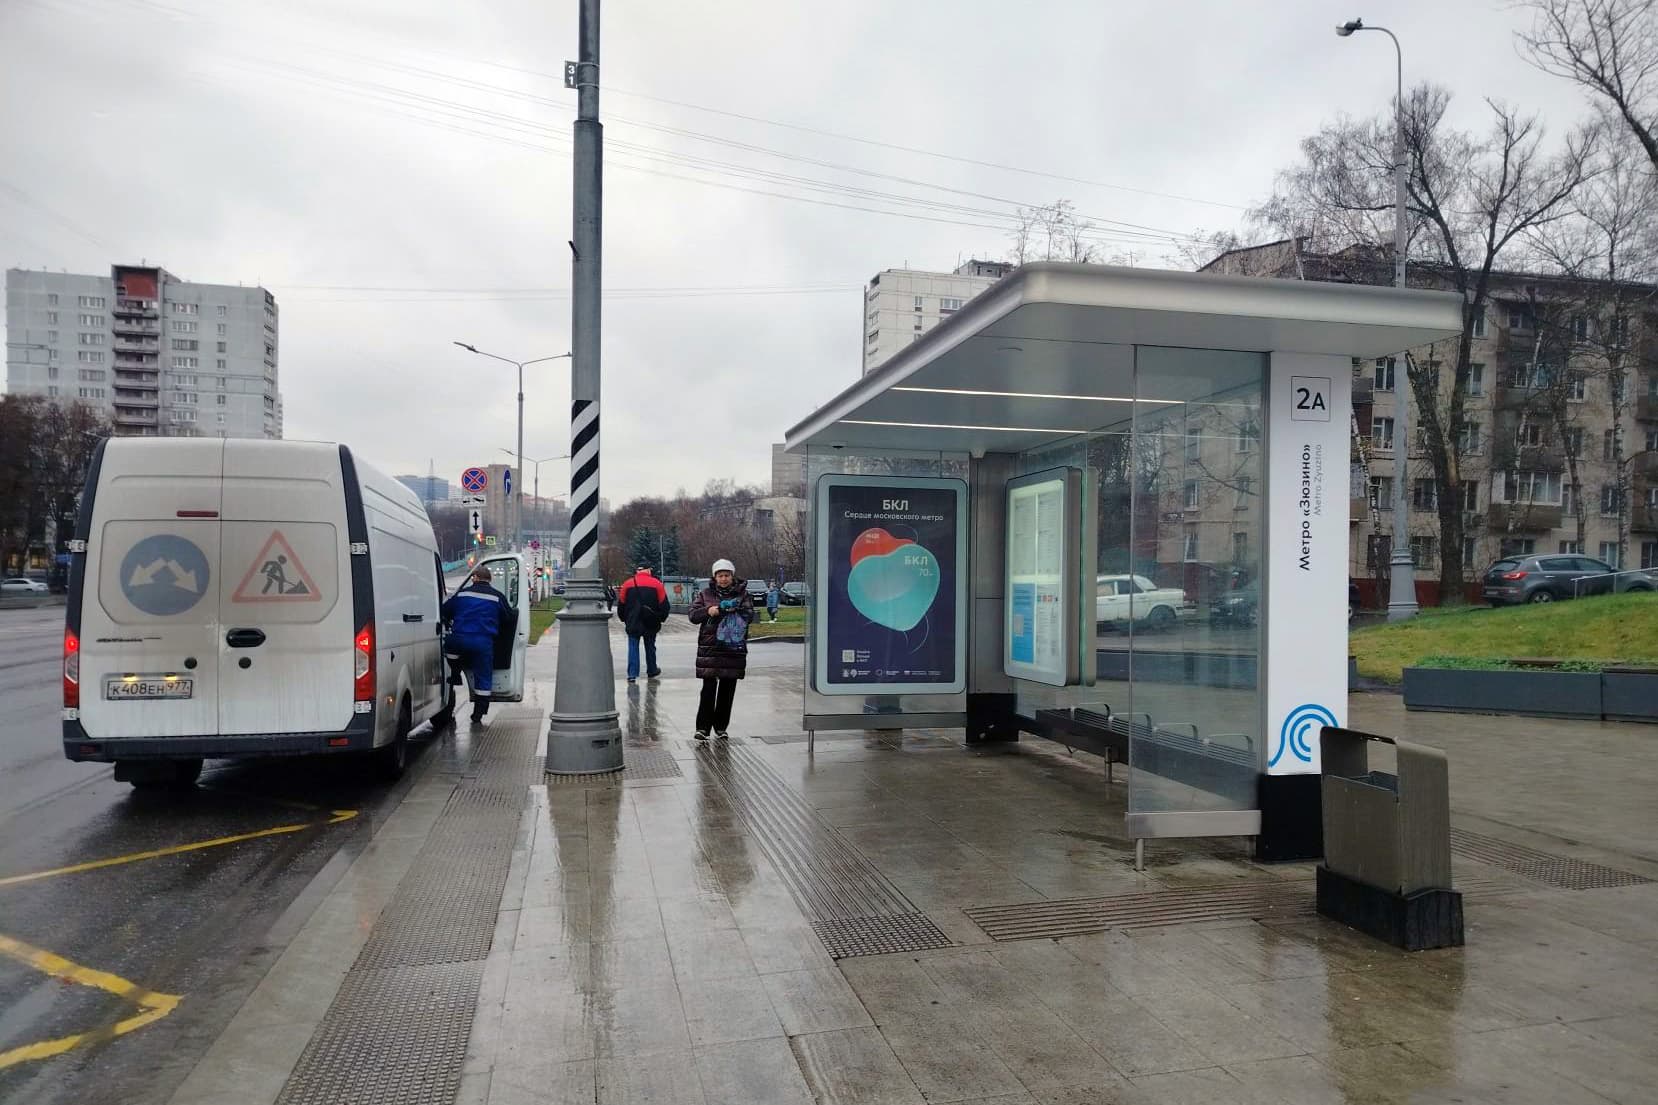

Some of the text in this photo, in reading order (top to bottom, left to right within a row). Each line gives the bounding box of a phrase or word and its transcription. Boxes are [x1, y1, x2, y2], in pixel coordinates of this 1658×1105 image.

[568, 65, 575, 75] 3
[568, 76, 574, 86] 1
[1296, 387, 1326, 411] 2А
[1313, 444, 1324, 516] Metro Zyuzino
[882, 499, 909, 511] БКЛ
[1299, 444, 1313, 571] Метро «Зюзино»
[844, 510, 944, 522] Сердце московского метро
[904, 555, 928, 566] БКЛ
